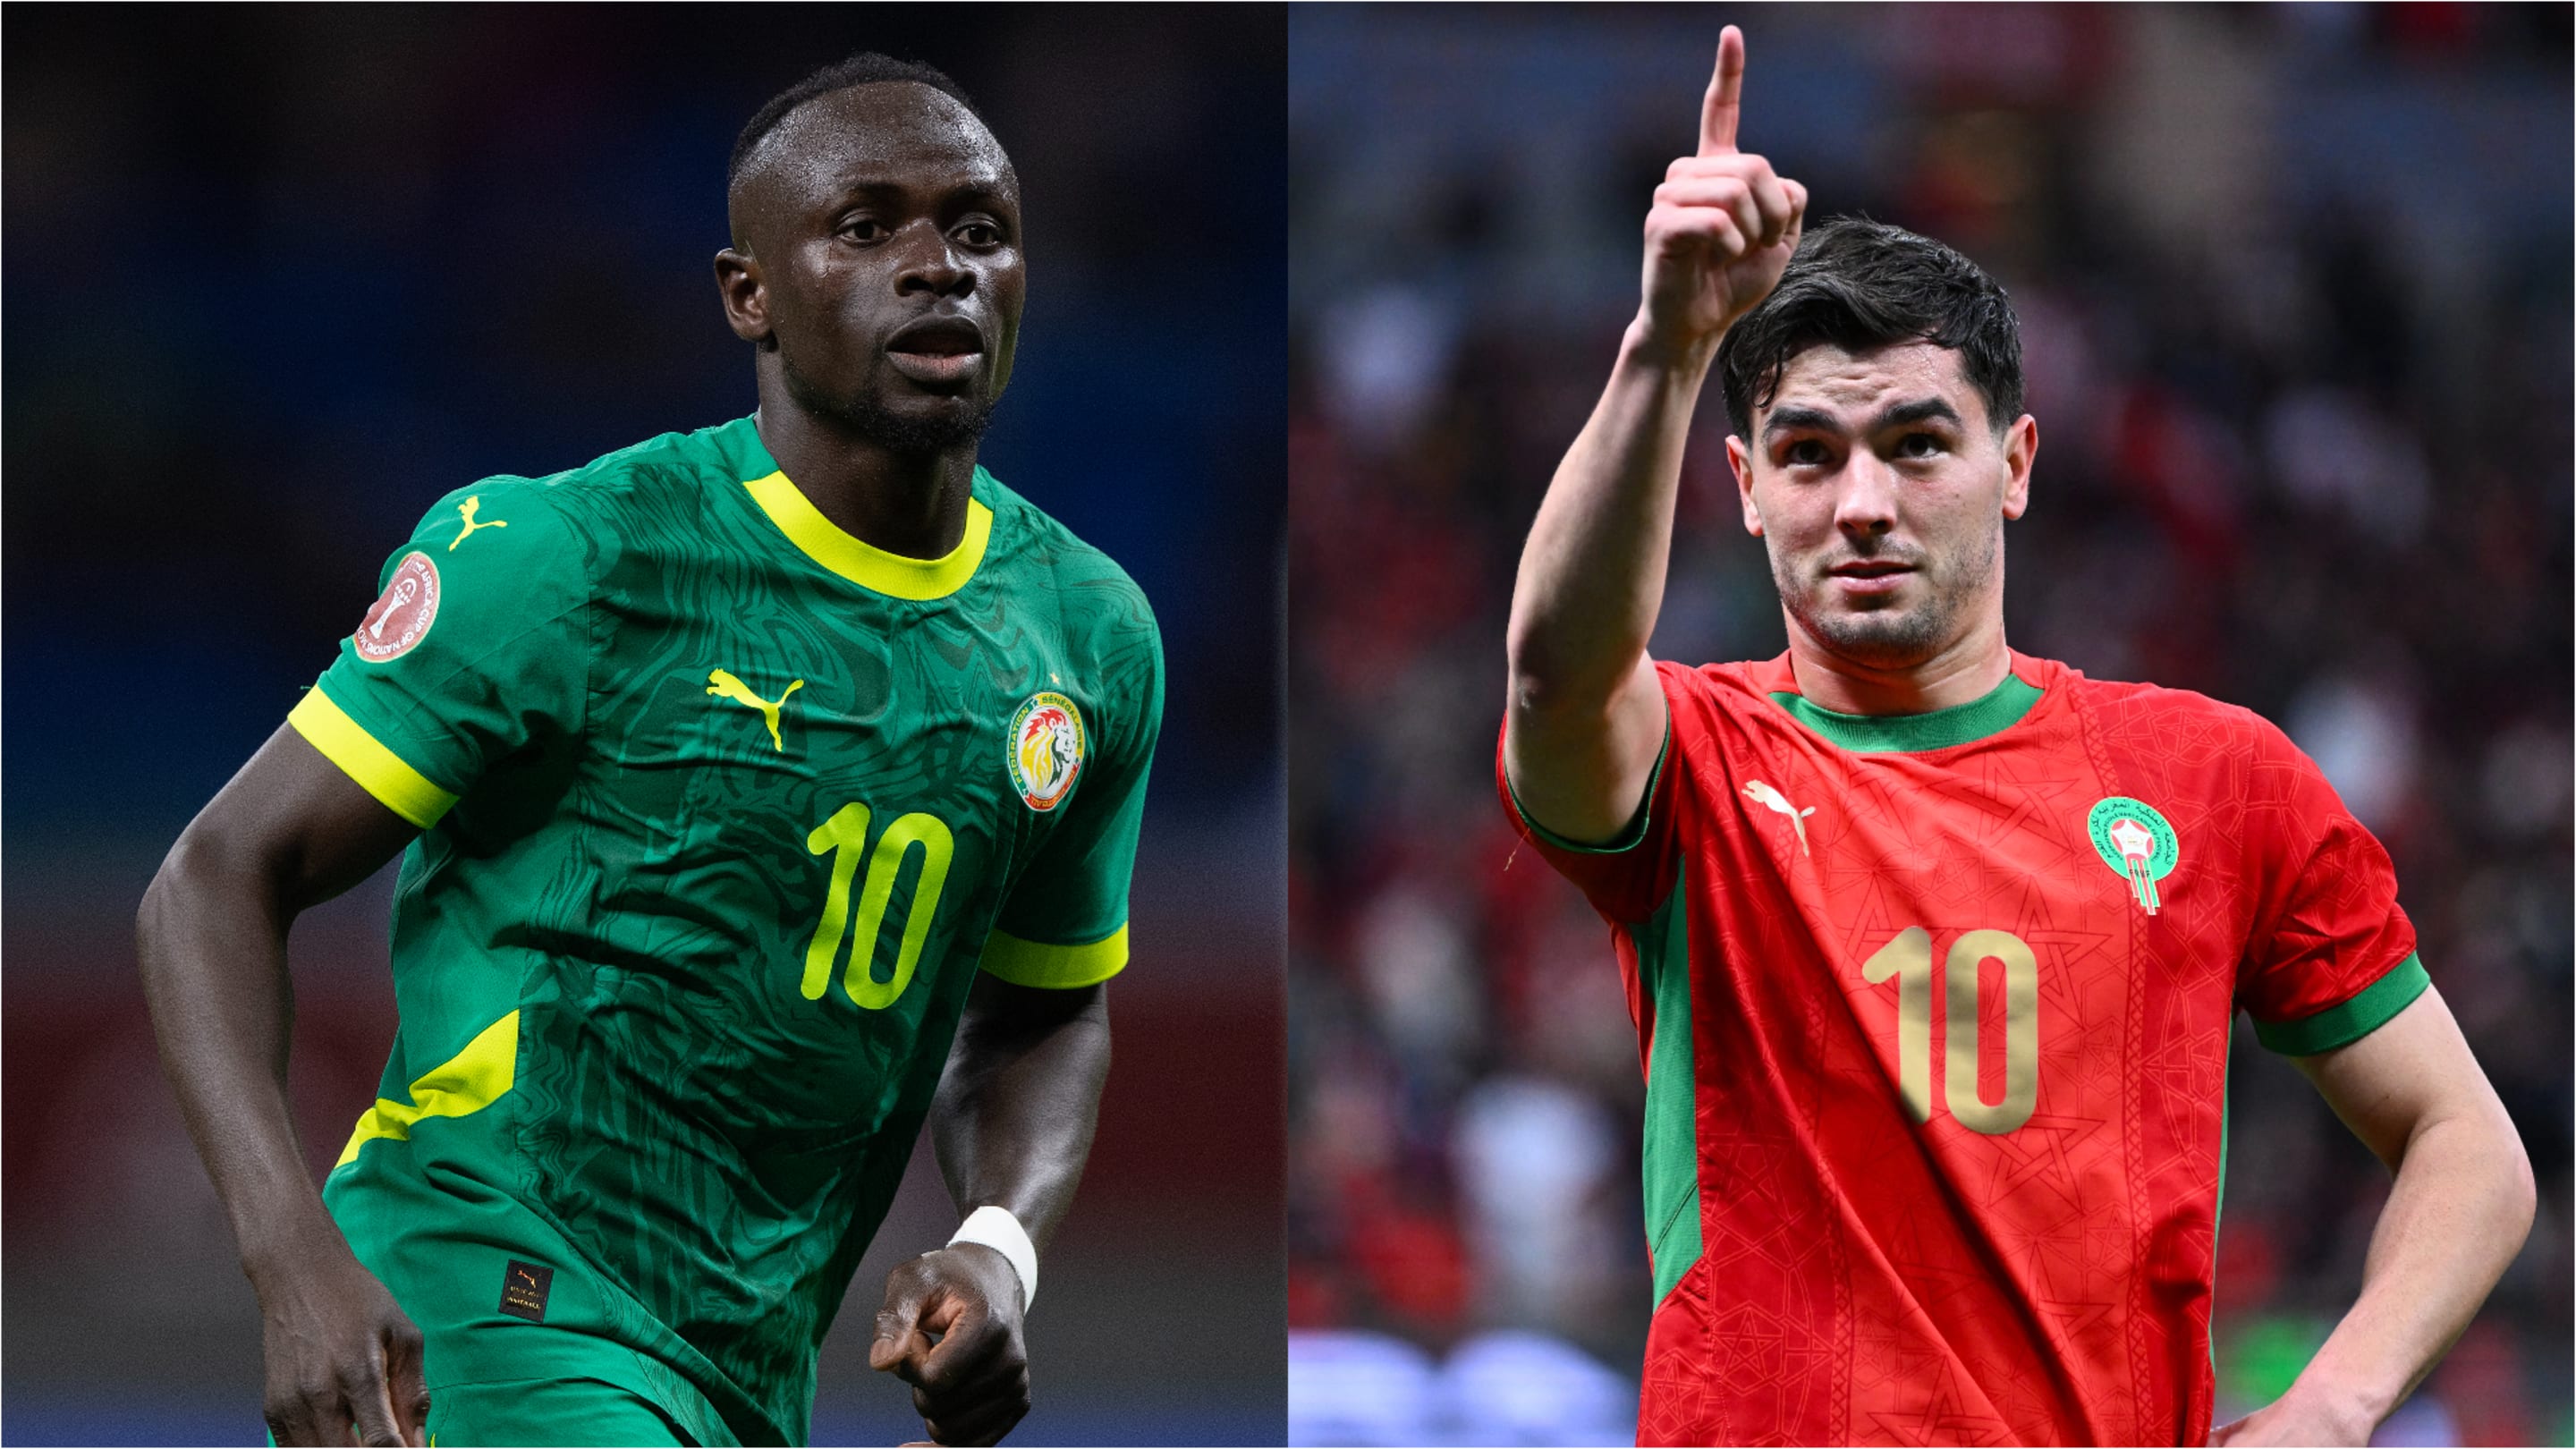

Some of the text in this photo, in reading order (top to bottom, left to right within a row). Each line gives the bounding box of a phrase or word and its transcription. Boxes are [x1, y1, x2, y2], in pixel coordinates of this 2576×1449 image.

[421, 571, 434, 607] AFRICA
[415, 608, 430, 632] CUP
[401, 631, 415, 647] OF
[801, 801, 954, 1010] 10
[1861, 926, 2038, 1135] 10
